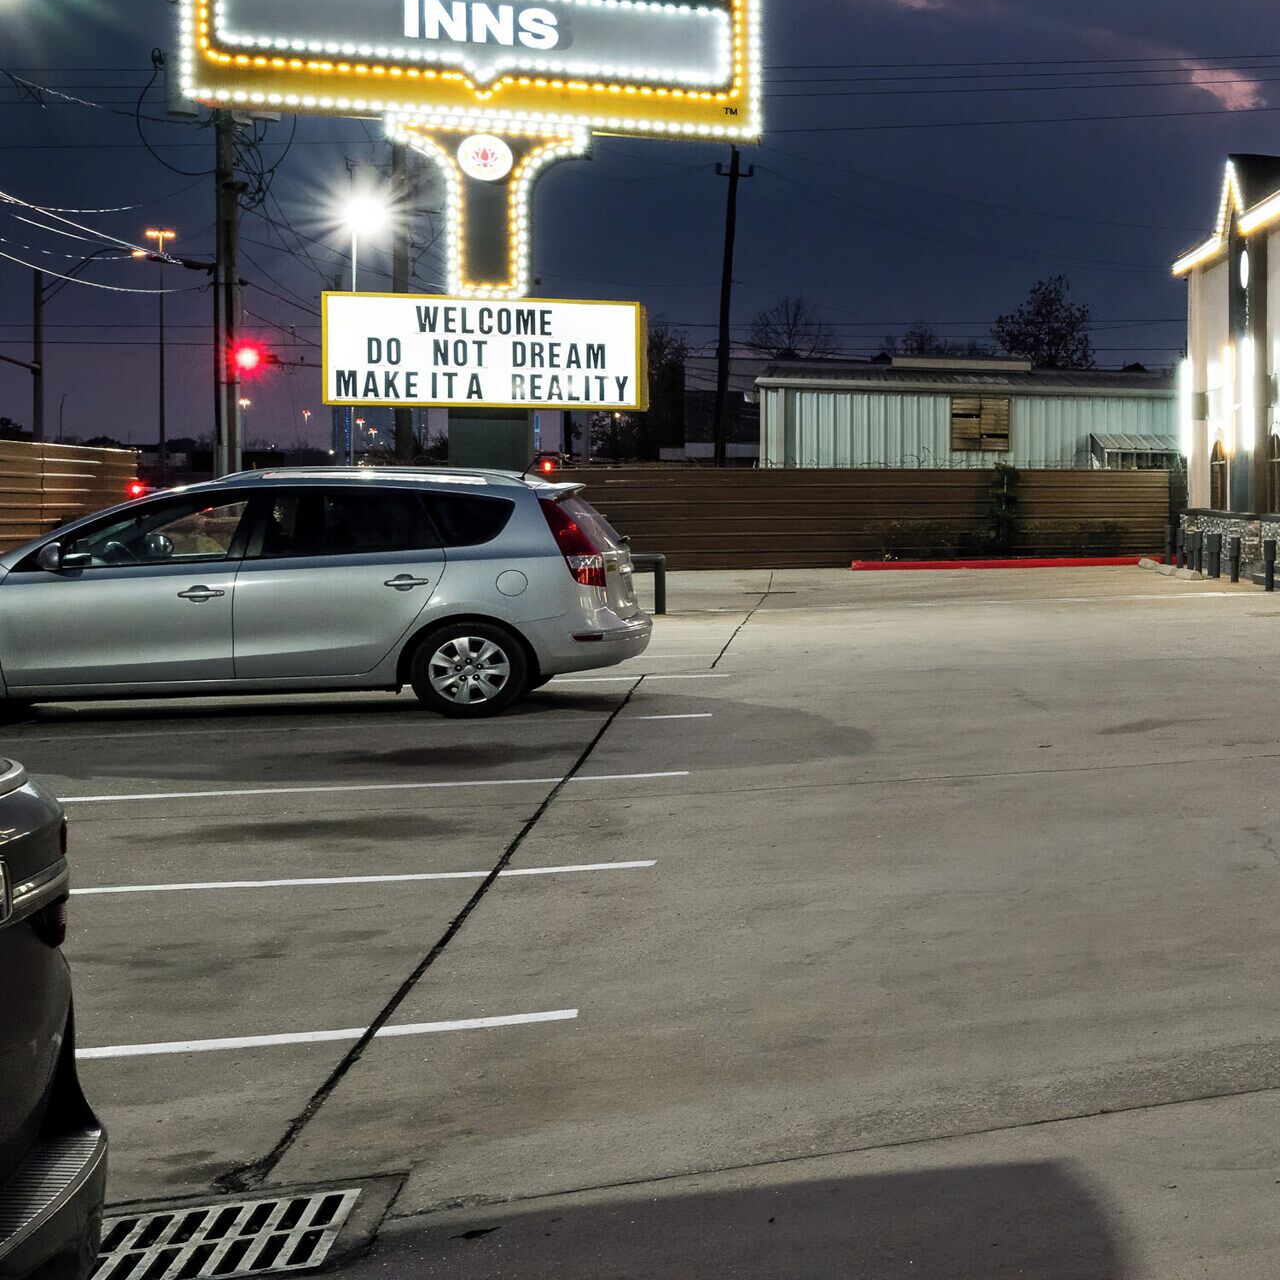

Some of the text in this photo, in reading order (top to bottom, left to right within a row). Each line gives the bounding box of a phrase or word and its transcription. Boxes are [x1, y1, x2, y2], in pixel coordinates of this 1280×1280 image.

[723, 106, 738, 116] TM
[415, 305, 553, 336] WELCOME
[367, 337, 606, 370] DO NOT DREAM
[335, 370, 419, 399] MAKE
[511, 374, 629, 402] REALITY
